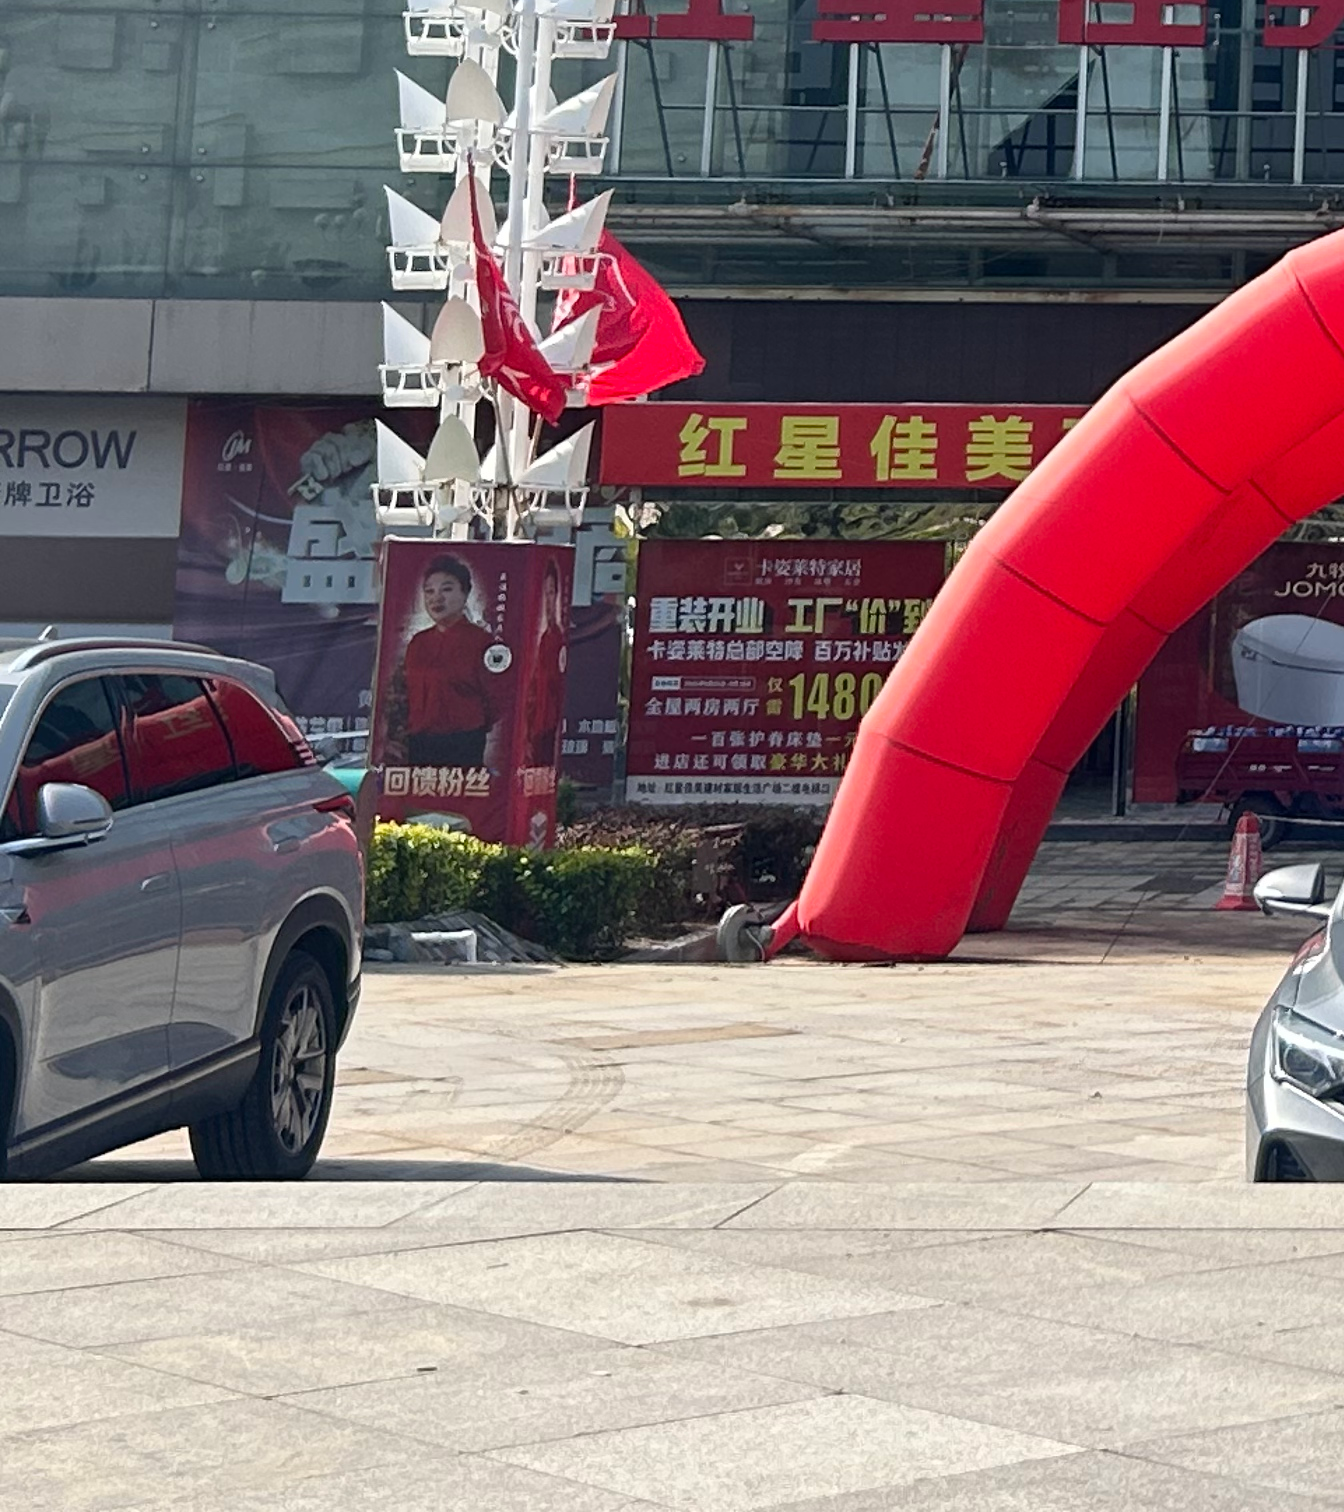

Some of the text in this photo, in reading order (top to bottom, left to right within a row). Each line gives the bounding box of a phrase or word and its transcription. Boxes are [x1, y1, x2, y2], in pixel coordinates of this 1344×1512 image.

[0, 482, 96, 508] 牌卫浴
[648, 596, 765, 634] 重装开业
[647, 640, 804, 662] 卡姿莱特总部空降
[383, 766, 491, 798] 回馈粉丝
